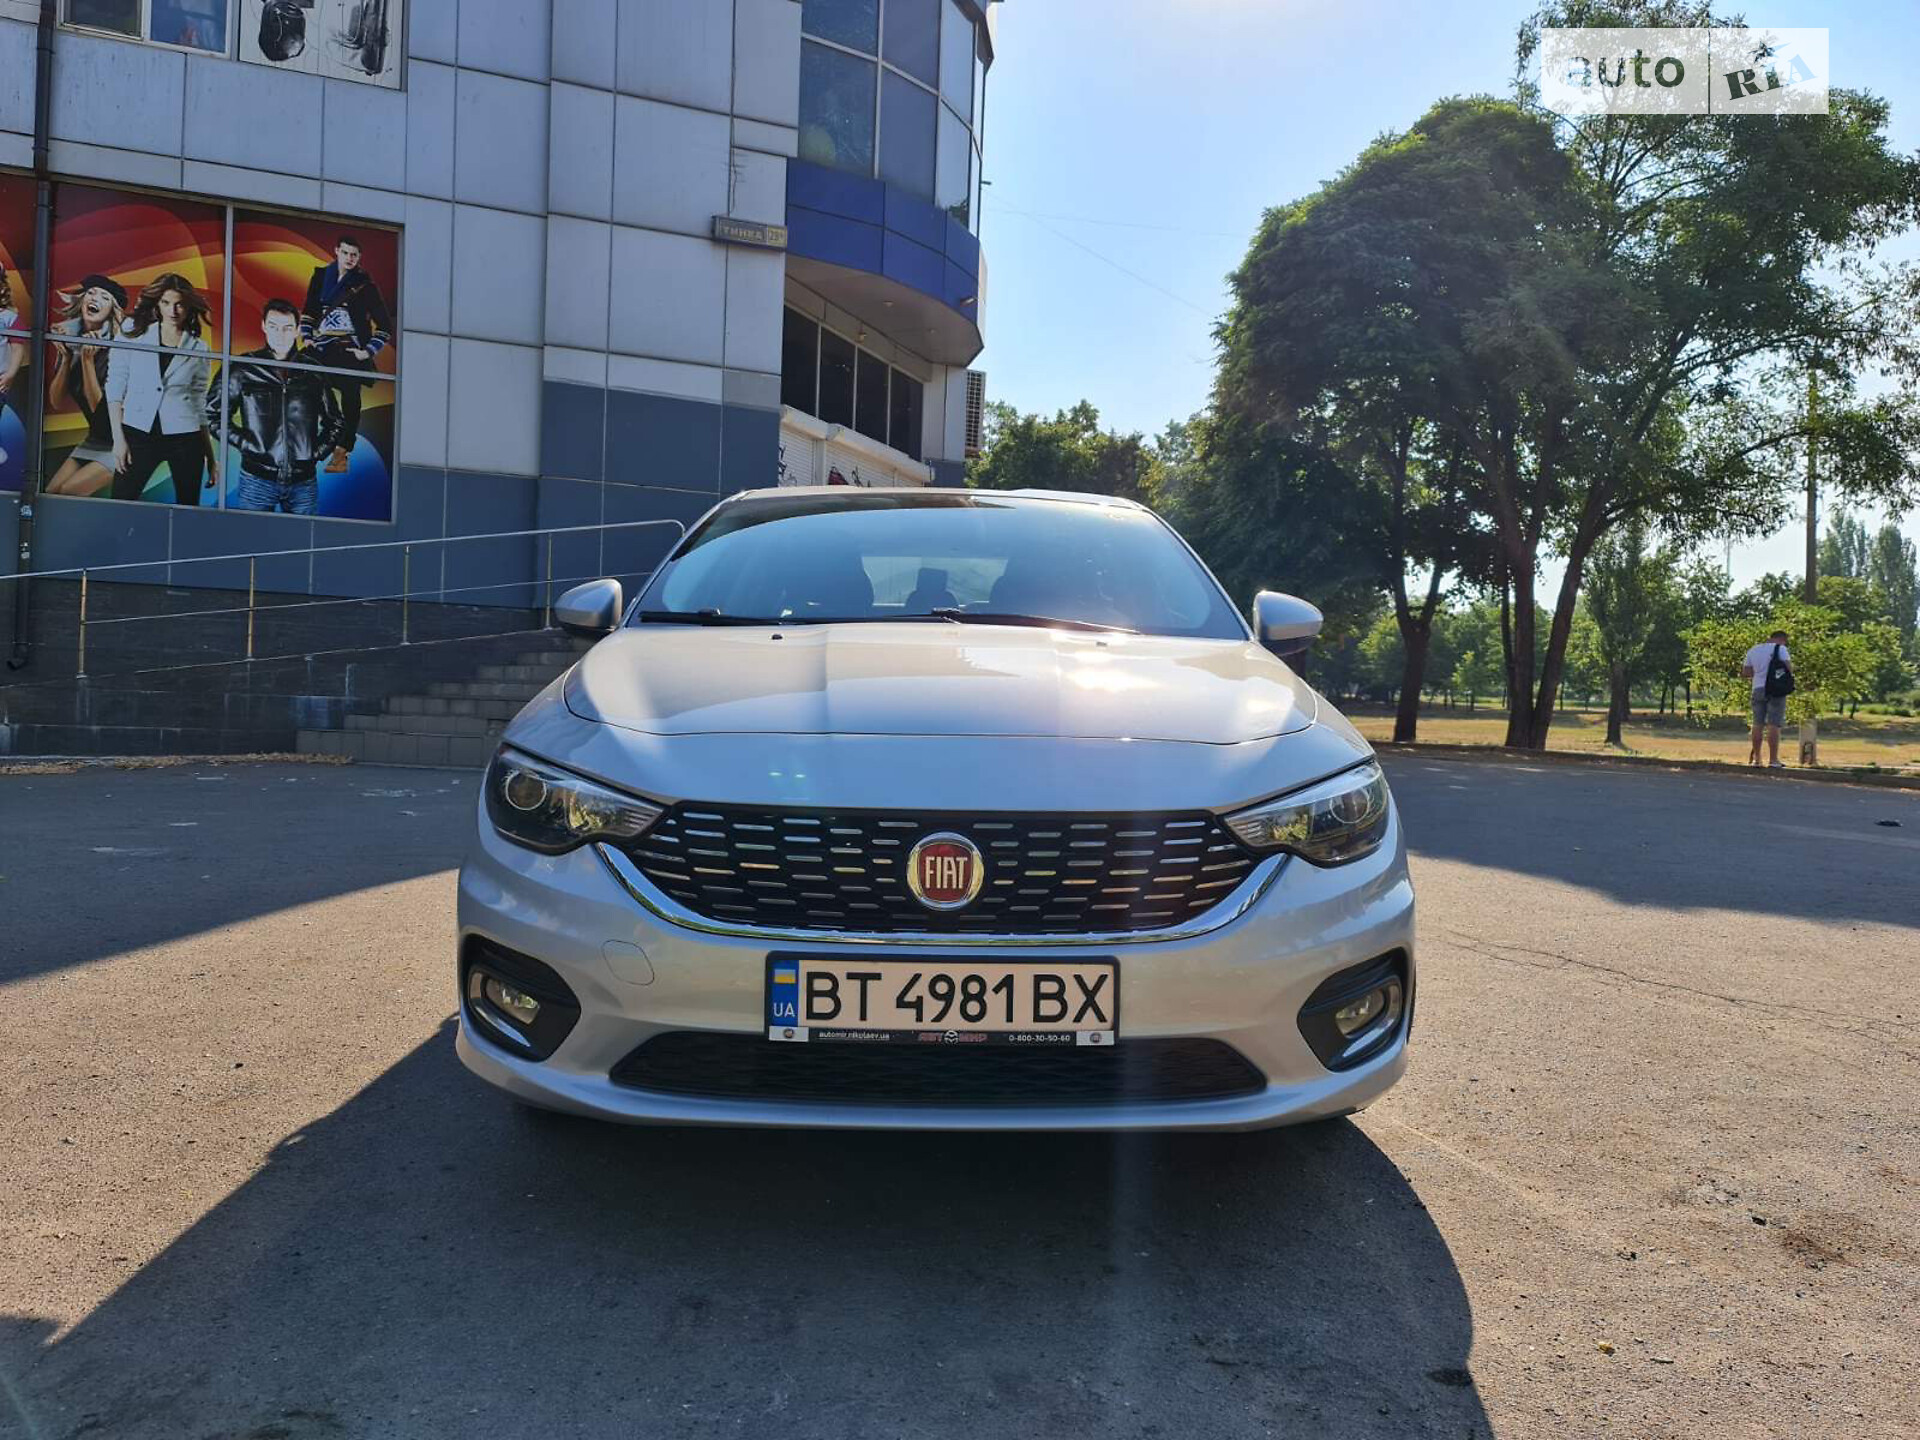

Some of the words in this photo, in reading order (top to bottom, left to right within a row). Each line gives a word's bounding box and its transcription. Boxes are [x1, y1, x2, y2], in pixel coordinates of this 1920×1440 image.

[925, 856, 968, 889] FIAT
[773, 1002, 796, 1018] UA
[805, 971, 882, 1021] BT
[895, 973, 1014, 1023] 4981
[1033, 974, 1109, 1023] BX
